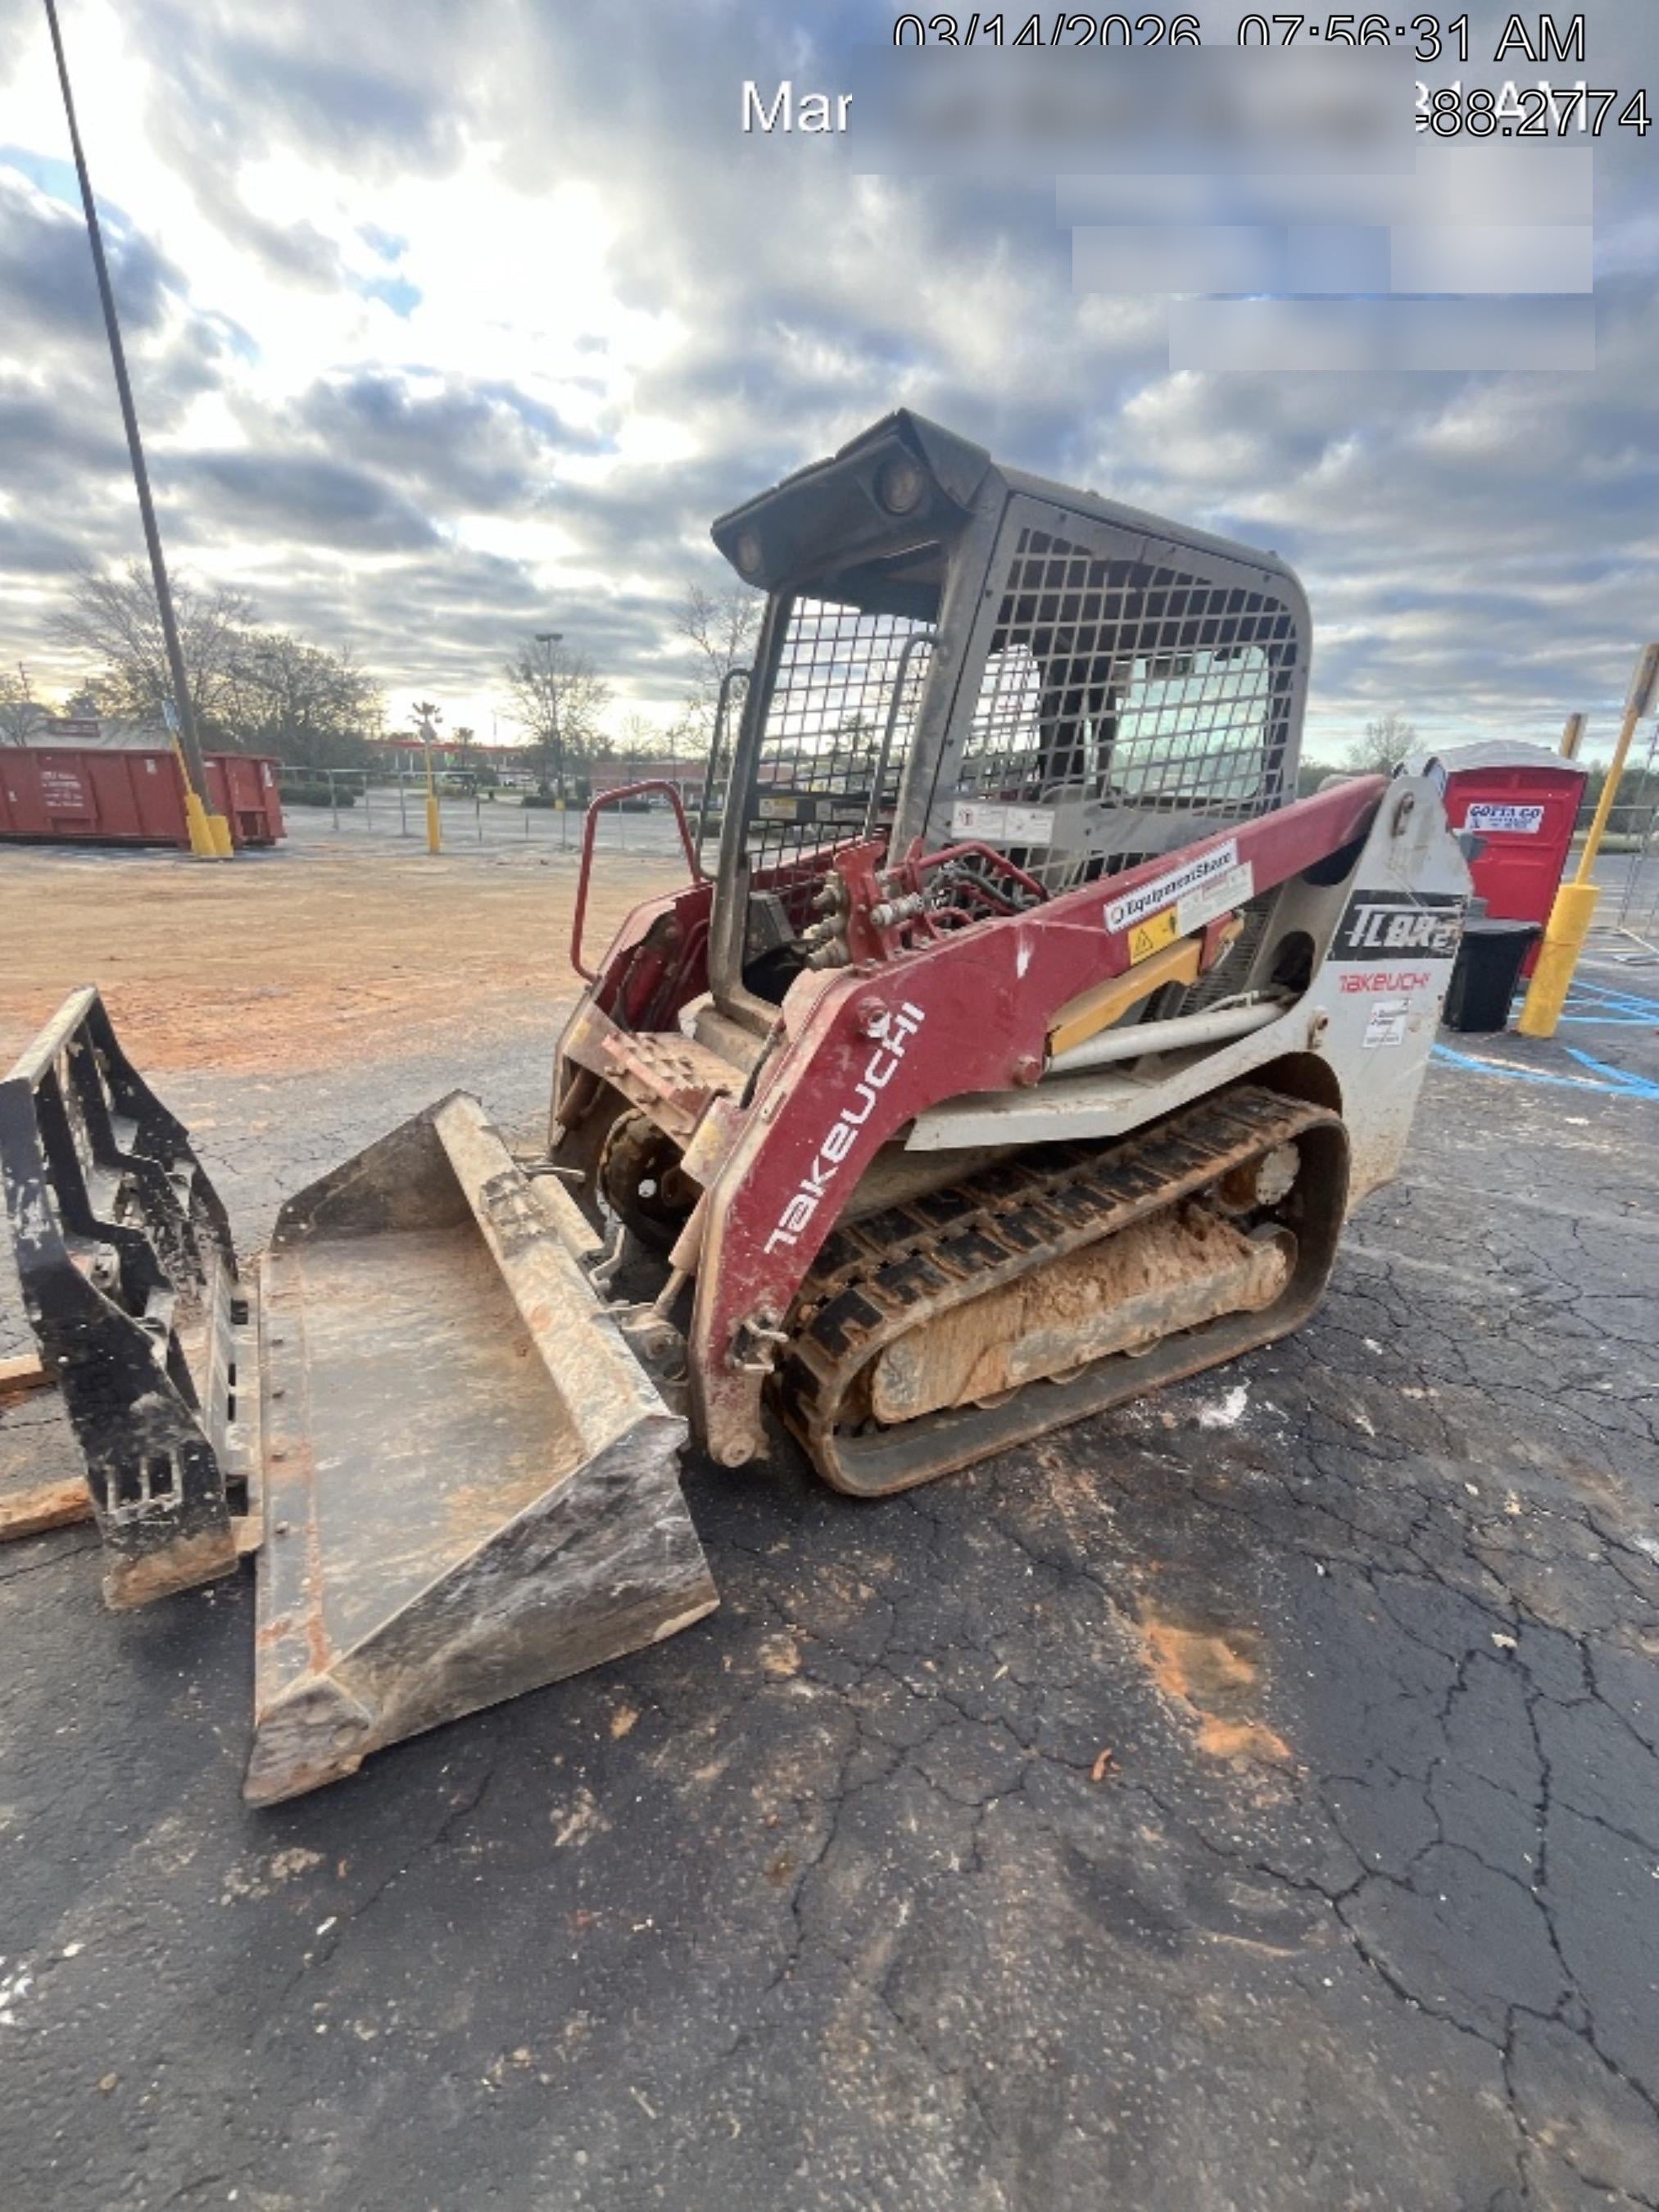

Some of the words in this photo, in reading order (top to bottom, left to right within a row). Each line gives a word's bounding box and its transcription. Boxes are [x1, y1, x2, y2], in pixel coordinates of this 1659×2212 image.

[1519, 808, 1541, 818] GO
[1126, 851, 1231, 916] EquipmentShare
[764, 1002, 925, 1253] TAKEUCHI
